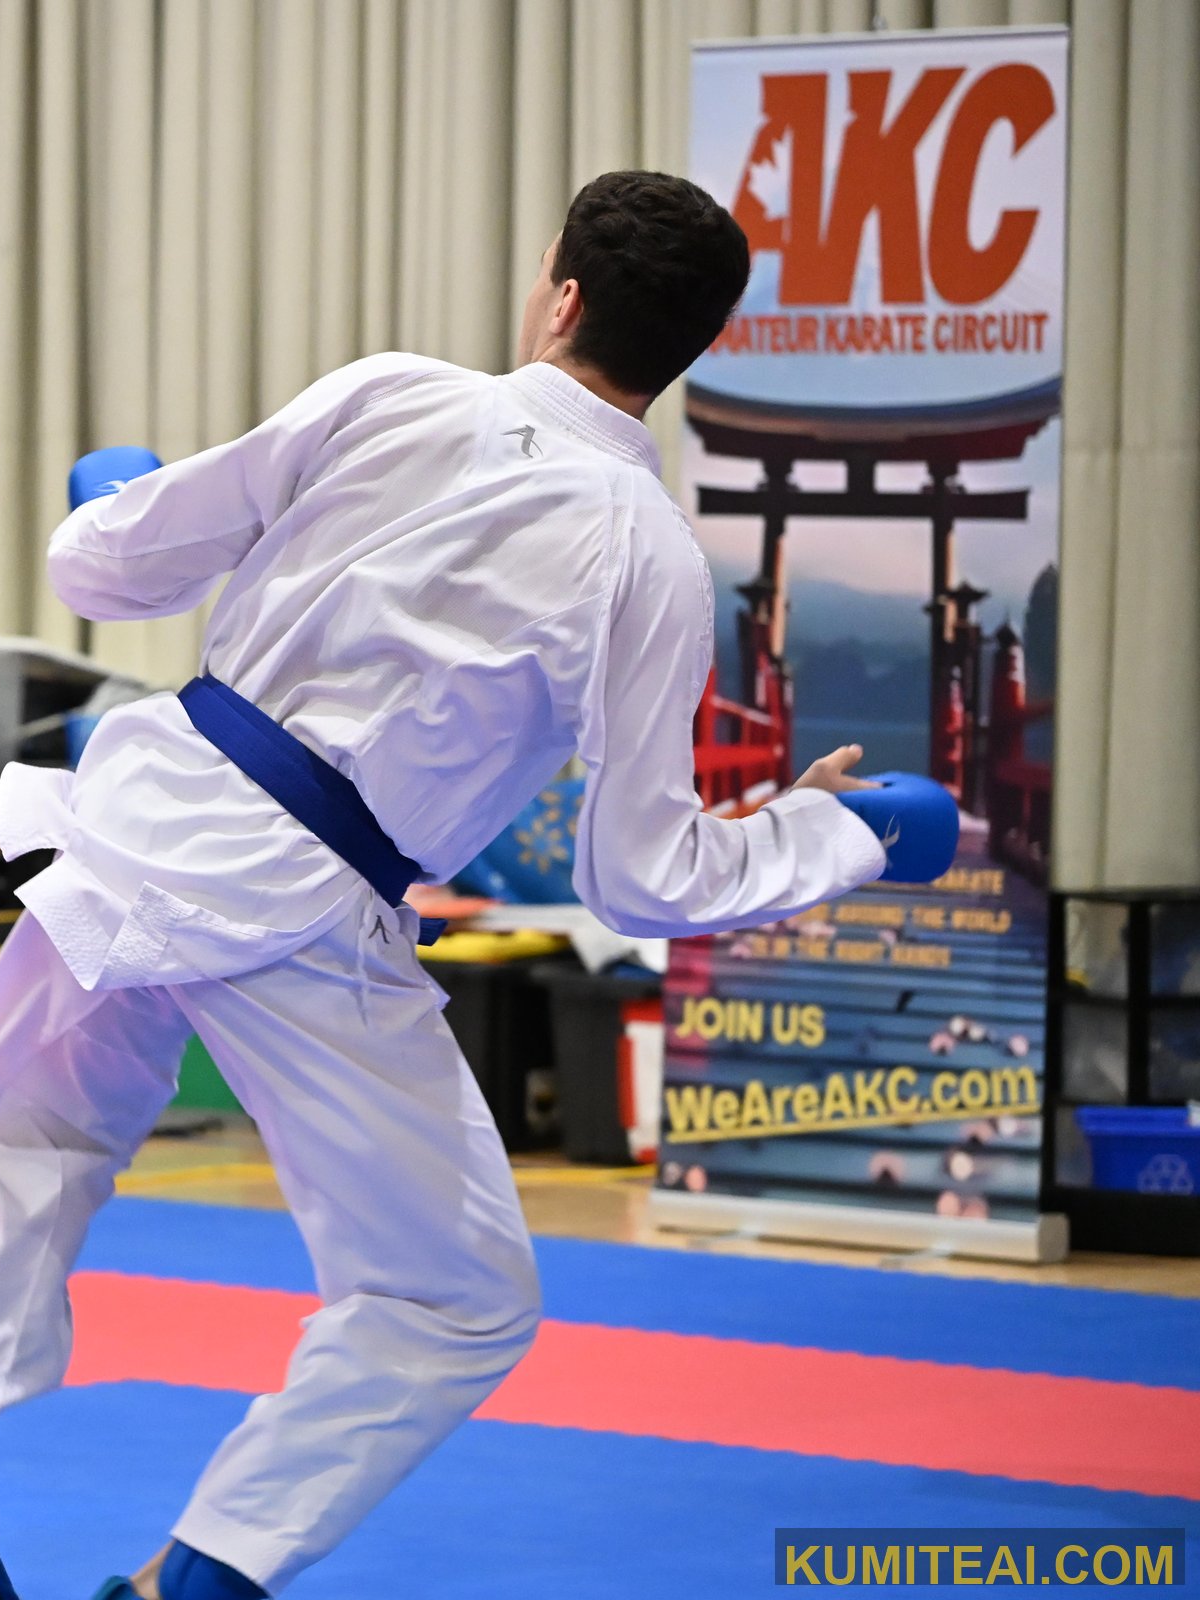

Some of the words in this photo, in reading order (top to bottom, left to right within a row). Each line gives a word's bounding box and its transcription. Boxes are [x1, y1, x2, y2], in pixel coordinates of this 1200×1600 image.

[733, 63, 1056, 307] AKC
[825, 314, 927, 353] KARATE
[933, 311, 1049, 353] CIRCUIT
[675, 997, 765, 1043] JOIN
[771, 1001, 826, 1048] US
[665, 1065, 1038, 1133] WeAreAKC.com
